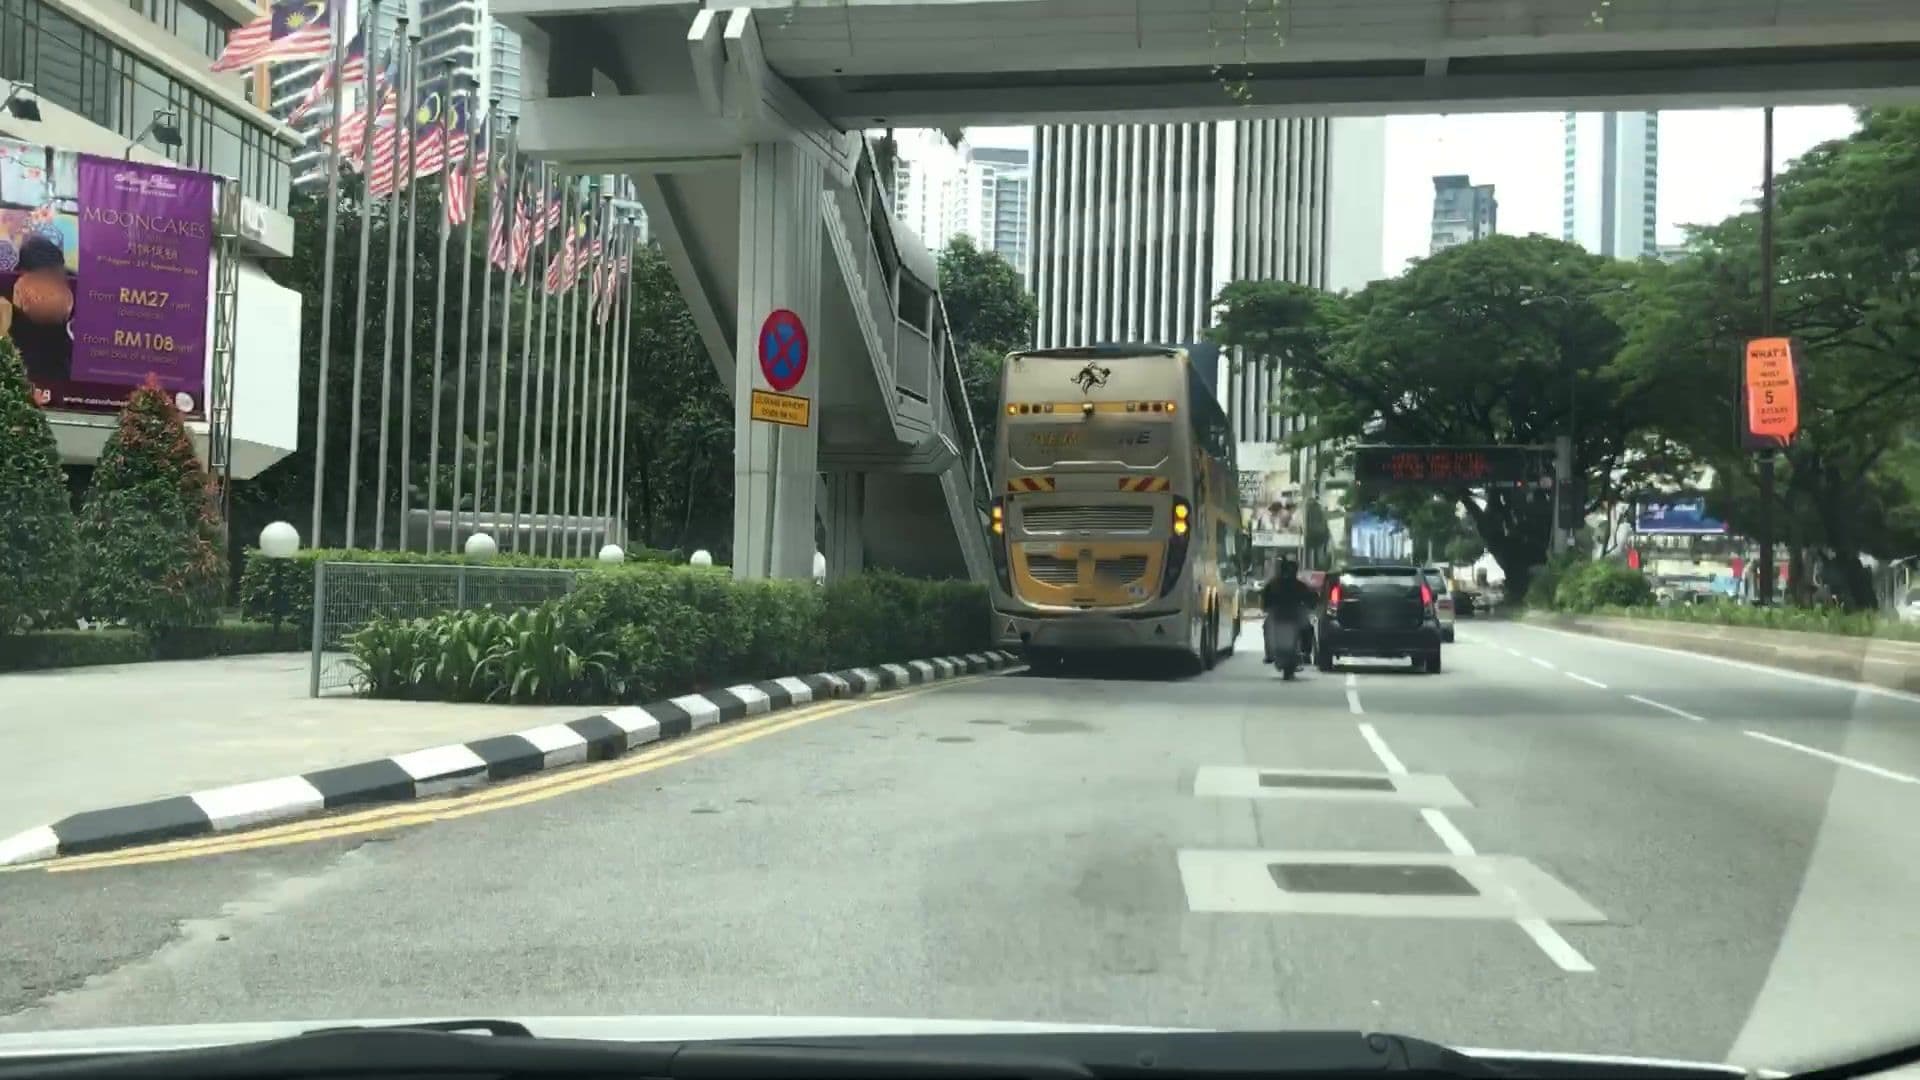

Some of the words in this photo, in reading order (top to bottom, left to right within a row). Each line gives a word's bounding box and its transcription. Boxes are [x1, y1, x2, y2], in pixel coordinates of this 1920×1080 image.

[83, 207, 205, 239] MOONCAKES
[120, 287, 169, 307] RM27
[115, 330, 174, 351] RM108
[1765, 390, 1774, 404] 5
